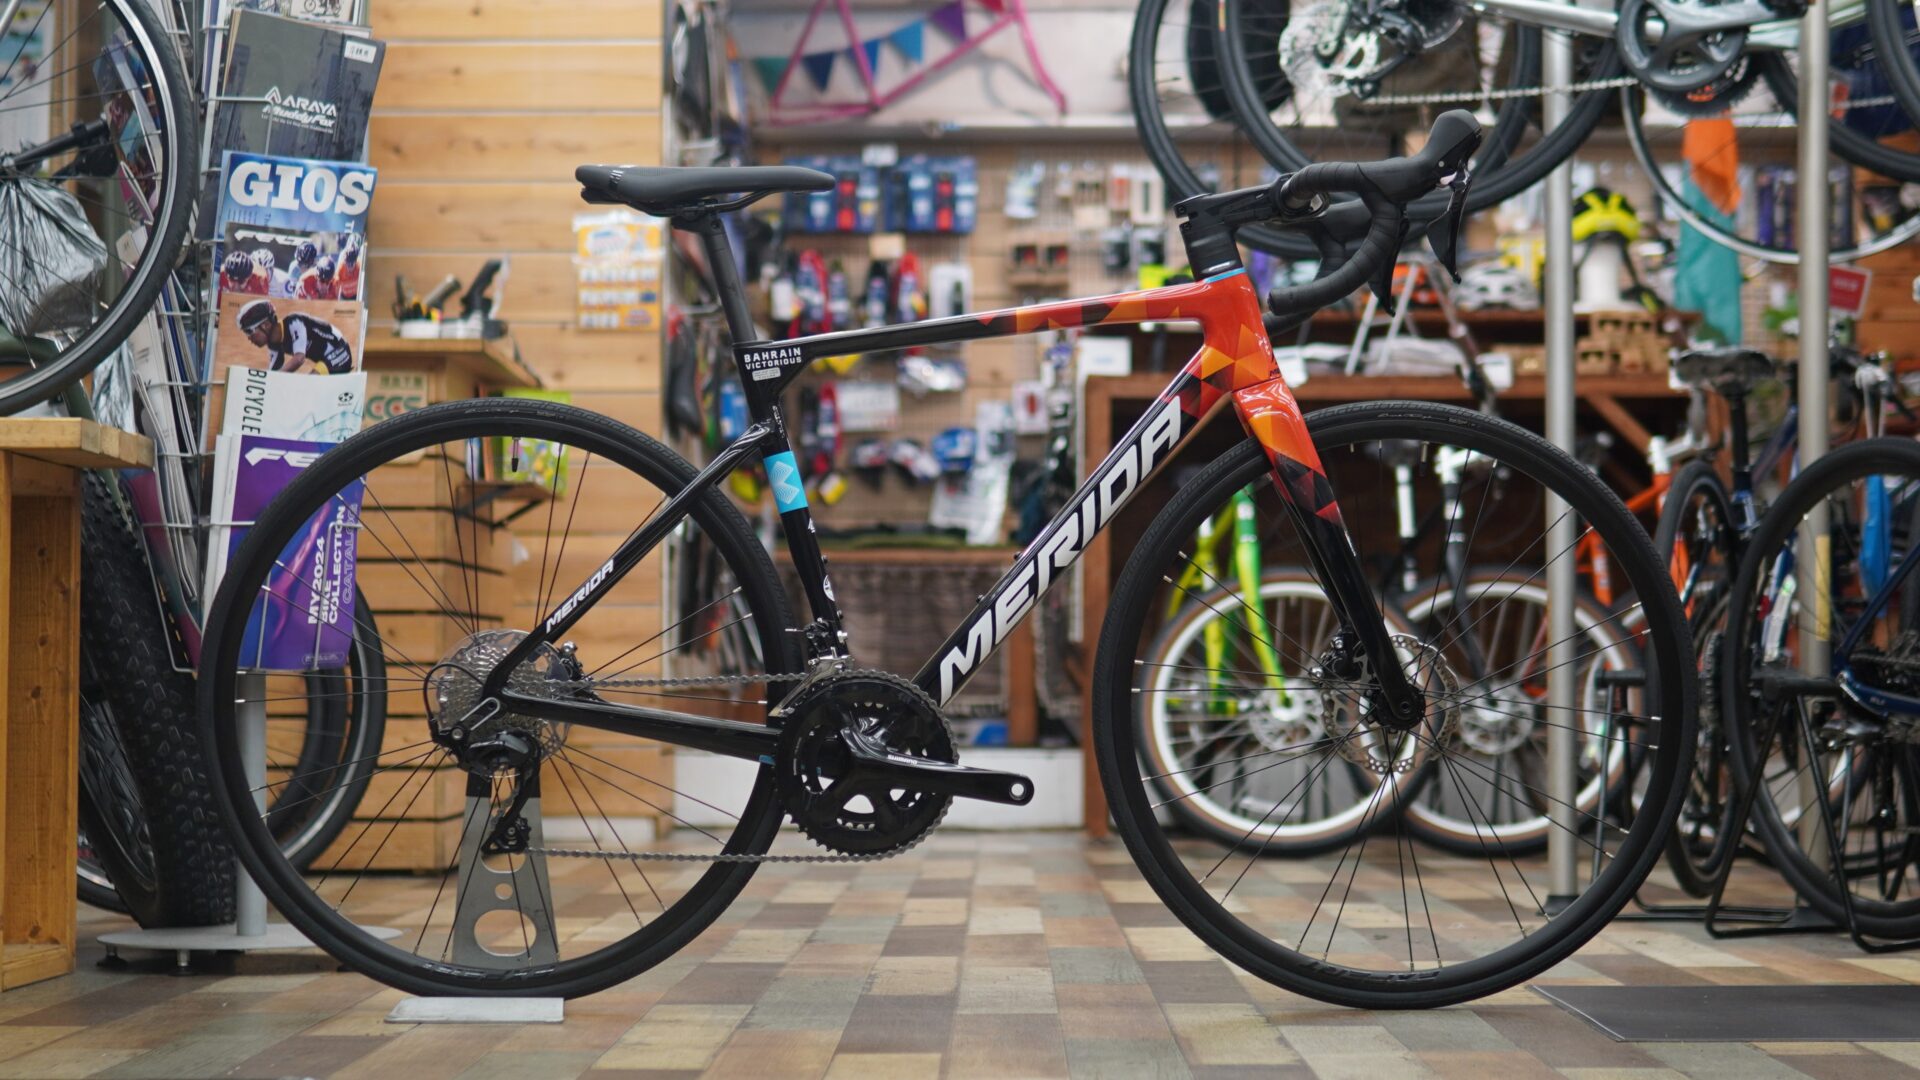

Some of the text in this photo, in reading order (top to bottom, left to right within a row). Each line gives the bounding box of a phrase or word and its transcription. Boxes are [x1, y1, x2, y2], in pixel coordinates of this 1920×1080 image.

[282, 94, 337, 117] ARAYA
[229, 161, 375, 216] GIOS
[743, 347, 802, 364] BAHRAIN
[745, 356, 802, 371] VICTORIOUS
[241, 368, 268, 435] BICYCLE
[307, 536, 327, 624] MY2024
[328, 505, 347, 624] COLLECTION
[940, 396, 1182, 707] MERIDA
[545, 558, 615, 634] MERIDA
